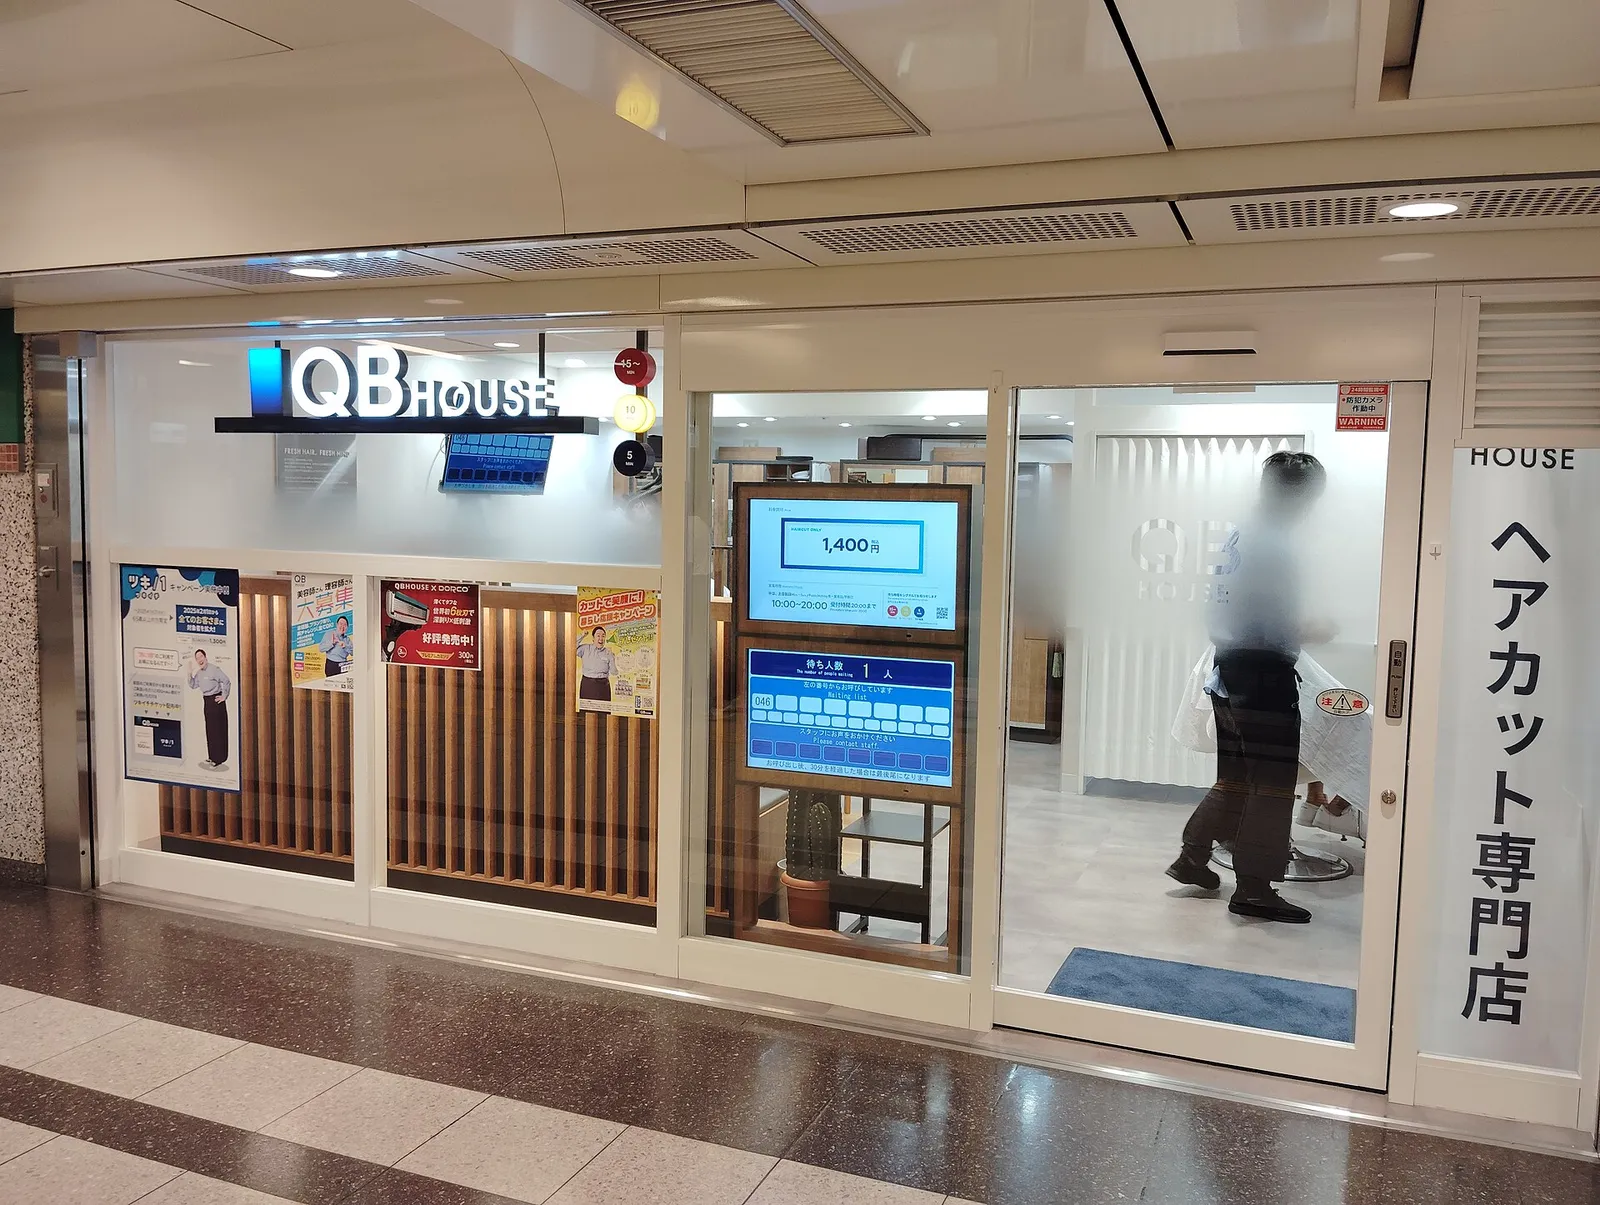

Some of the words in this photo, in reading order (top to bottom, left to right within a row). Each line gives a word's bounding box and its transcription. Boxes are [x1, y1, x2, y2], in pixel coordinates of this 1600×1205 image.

[291, 345, 407, 418] QB
[411, 377, 555, 418] HOUSE
[1346, 396, 1384, 404] 防犯カメラ
[625, 405, 636, 414] 10
[1338, 418, 1384, 426] WARNING
[626, 451, 633, 460] 5
[1471, 448, 1575, 470] HOUSE
[822, 537, 869, 554] 1,400
[871, 544, 880, 554] 円
[1130, 518, 1240, 575] QB
[294, 574, 307, 584] QB
[297, 586, 353, 622] 大募集
[579, 591, 644, 613] カットで笑顔に!
[178, 615, 225, 626] 全てのお客さまに
[422, 632, 474, 646] 好評発売中!
[1393, 650, 1402, 667] 自動
[806, 659, 844, 671] 待ち人数
[883, 669, 893, 679] 人
[803, 681, 894, 694] 左の番号からお呼びしています
[755, 696, 770, 706] 046
[827, 691, 851, 700] Waiting
[800, 728, 896, 742] スタッフにお声をおかけください
[813, 737, 833, 745] Please
[835, 740, 858, 748] contact
[1461, 522, 1552, 1025] ヘアカット専門店
